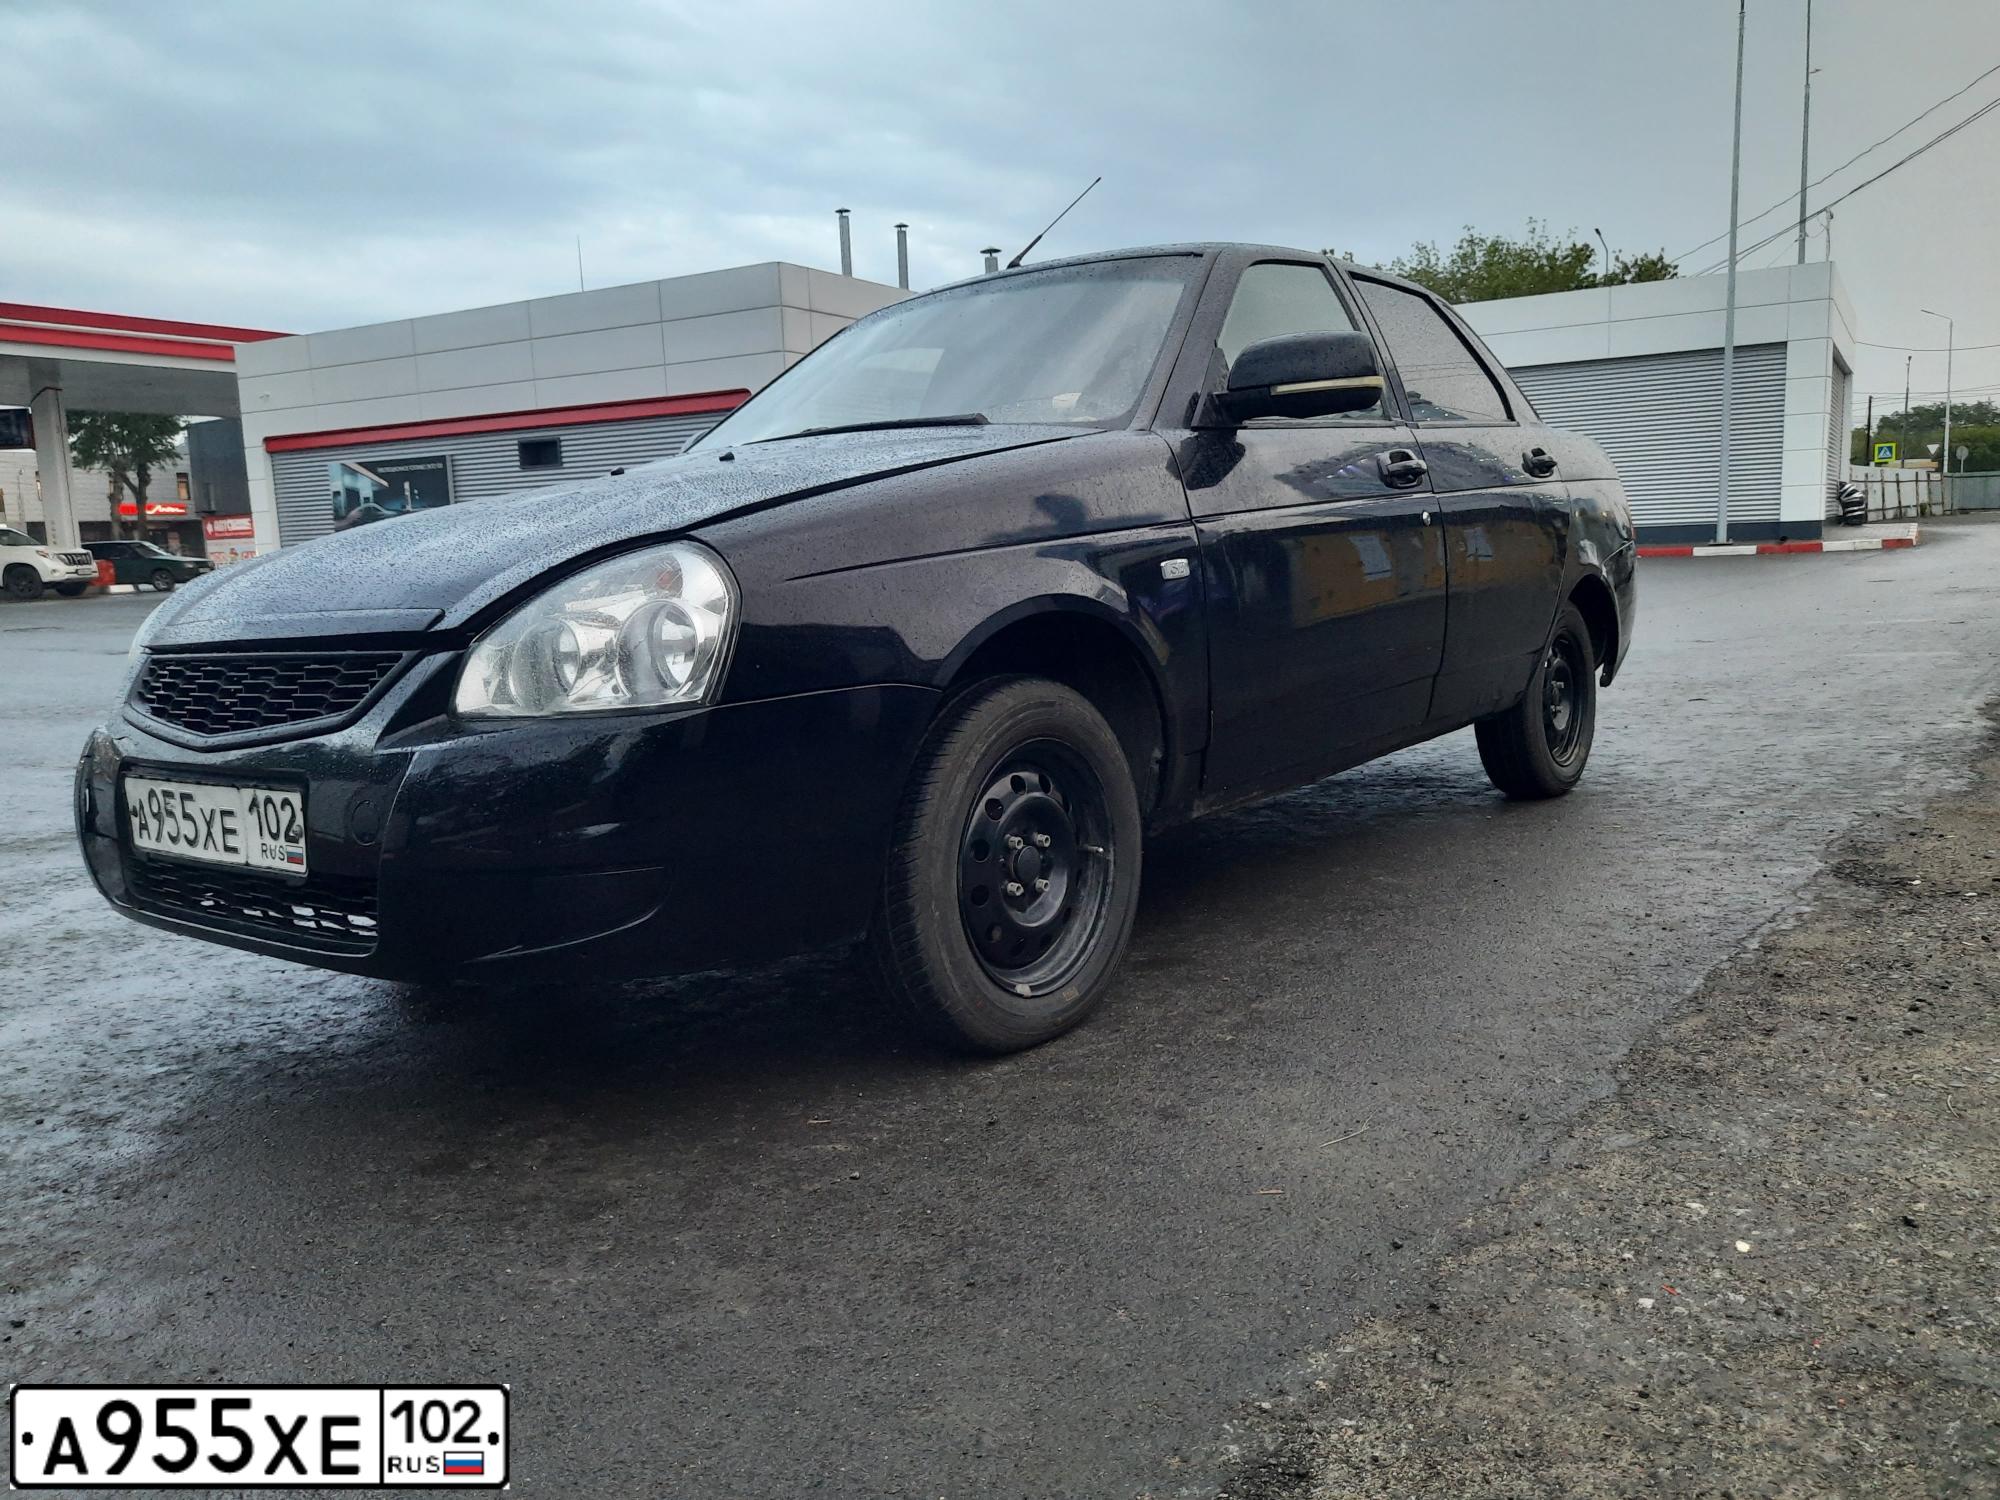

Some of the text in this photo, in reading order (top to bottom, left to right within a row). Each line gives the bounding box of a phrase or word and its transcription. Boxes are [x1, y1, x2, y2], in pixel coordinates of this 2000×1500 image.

[138, 787, 301, 854] А955ХЕ 102
[260, 843, 286, 861] RUS
